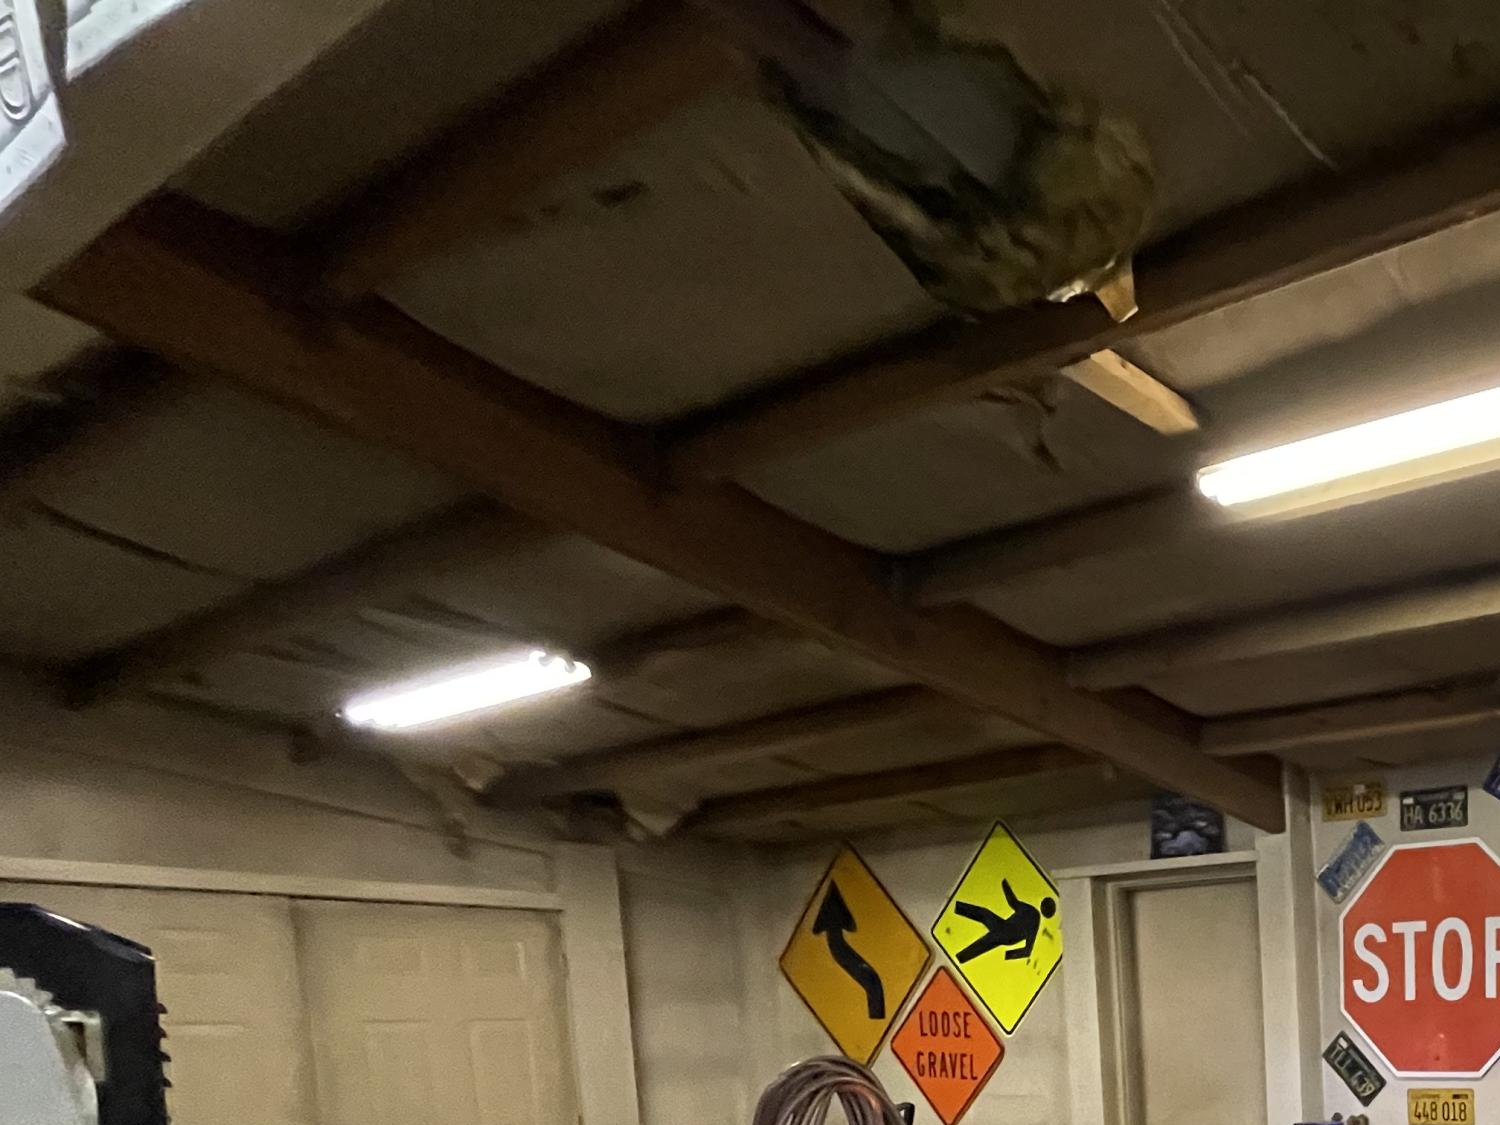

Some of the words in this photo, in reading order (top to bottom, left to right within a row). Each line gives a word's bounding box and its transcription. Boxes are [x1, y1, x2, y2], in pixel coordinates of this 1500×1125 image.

[1403, 804, 1424, 825] HA
[918, 1011, 972, 1039] LOOSE
[916, 1052, 978, 1081] GRAVEL
[1414, 1101, 1438, 1121] 448
[1442, 1101, 1467, 1122] 018
